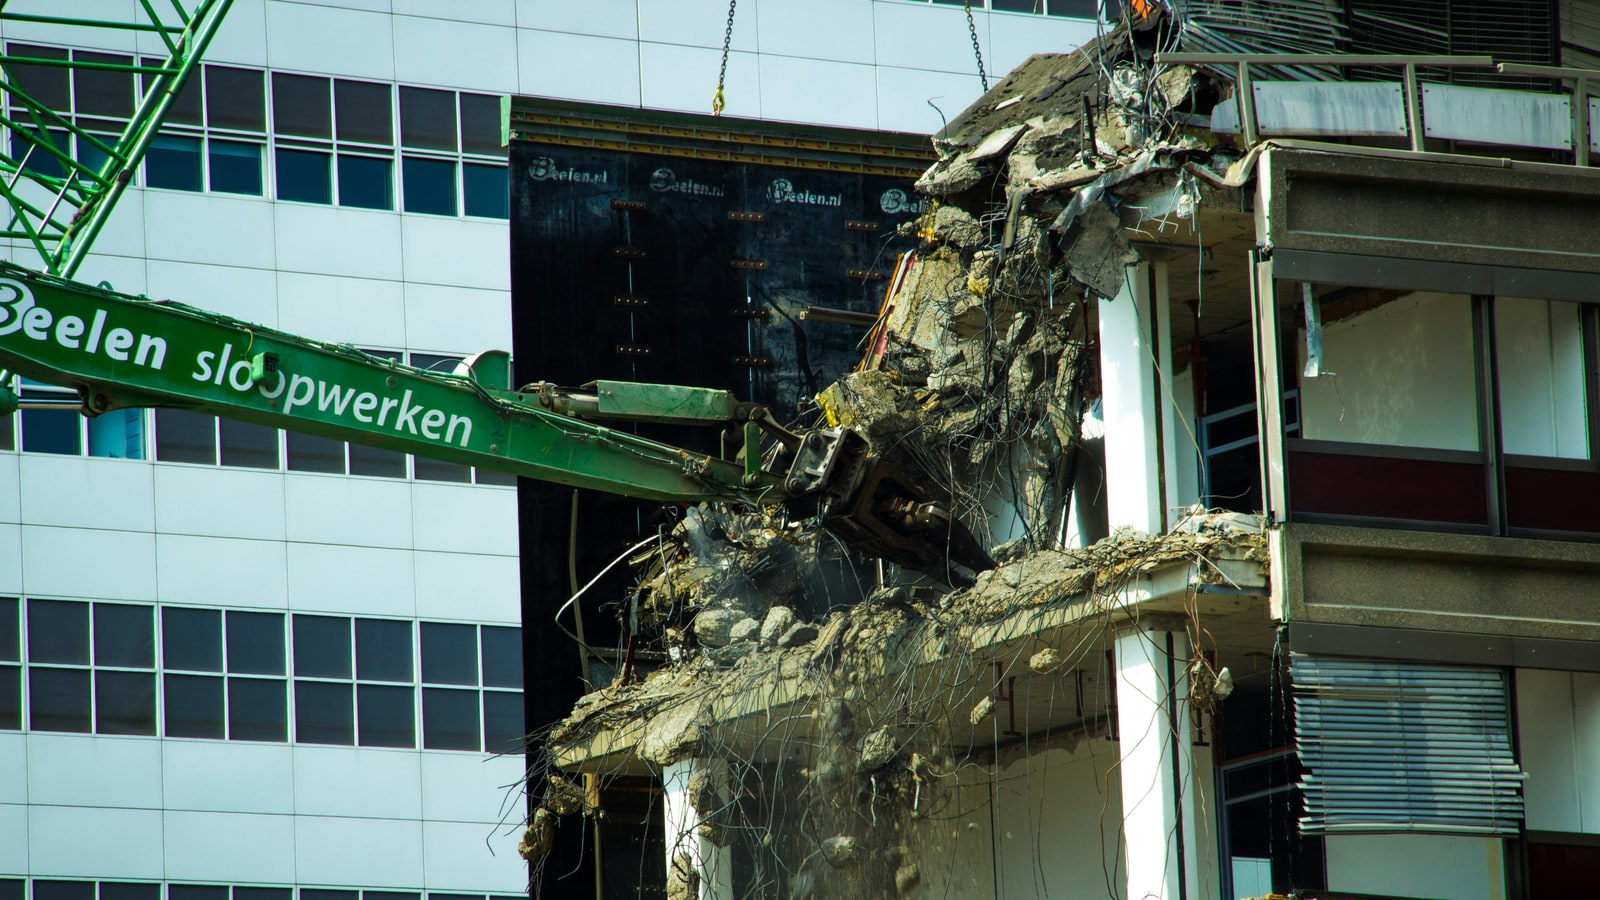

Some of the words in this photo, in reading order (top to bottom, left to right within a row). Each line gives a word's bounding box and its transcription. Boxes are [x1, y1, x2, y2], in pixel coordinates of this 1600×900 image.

[528, 156, 607, 183] Beelen.nl
[650, 168, 725, 197] Beelen.nl
[766, 178, 842, 206] Beelen.nl
[880, 189, 930, 213] Beel
[0, 278, 167, 370] Beelen
